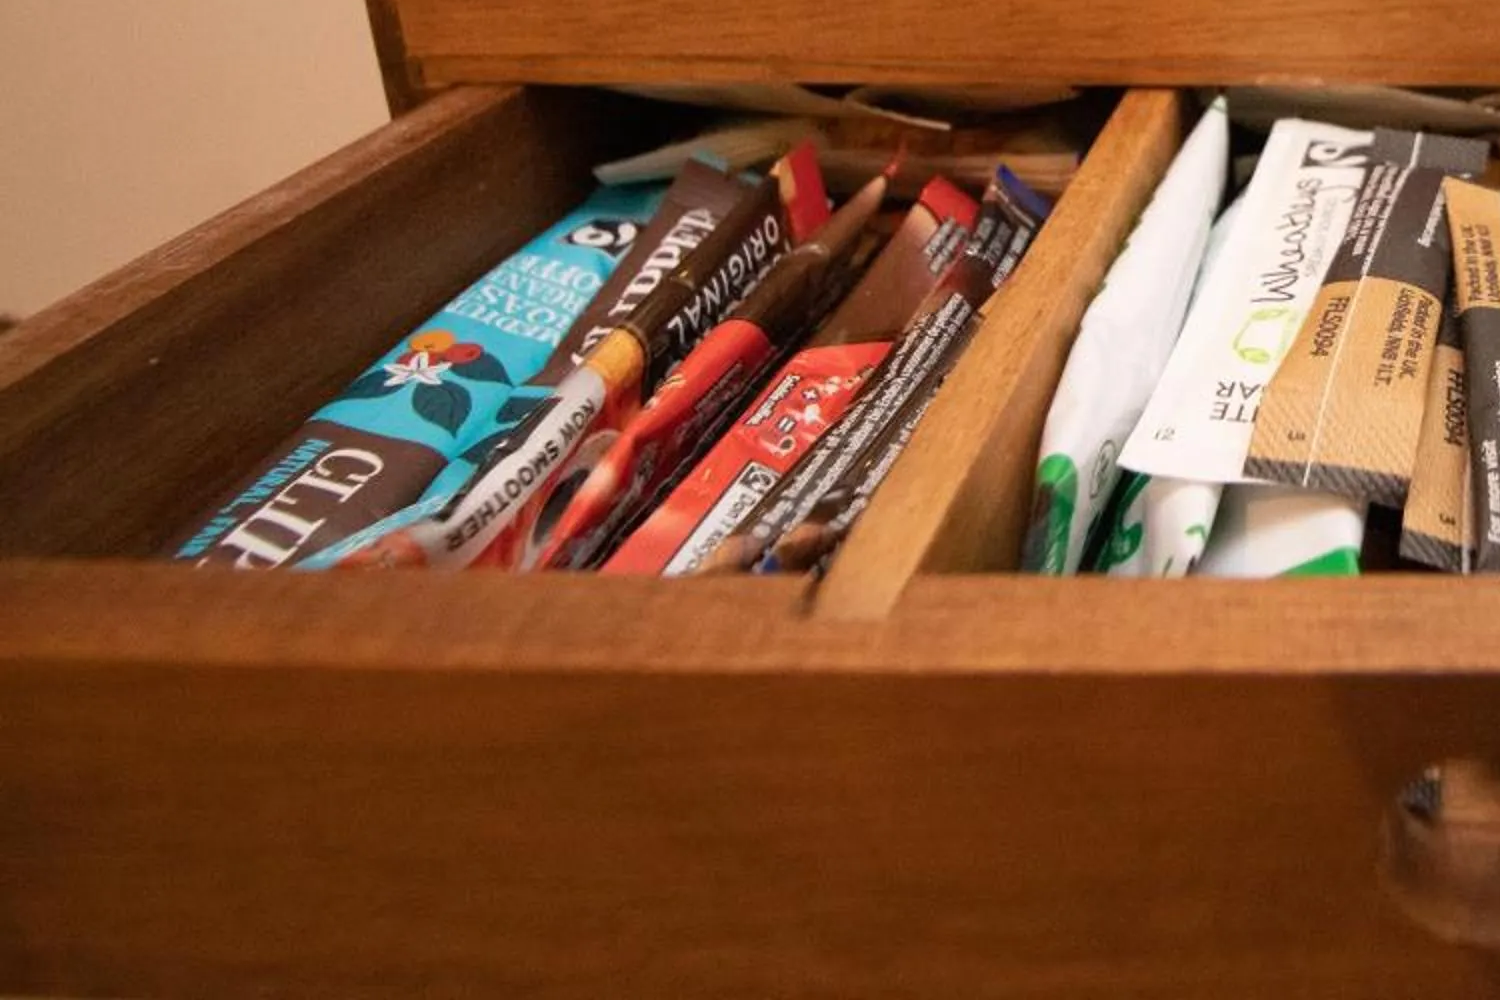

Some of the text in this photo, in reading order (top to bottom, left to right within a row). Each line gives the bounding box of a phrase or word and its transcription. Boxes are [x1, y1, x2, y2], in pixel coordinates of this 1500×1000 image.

[667, 214, 779, 345] ORIGINAL
[216, 448, 385, 571] CLIP
[445, 439, 561, 551] SMOOTHER
